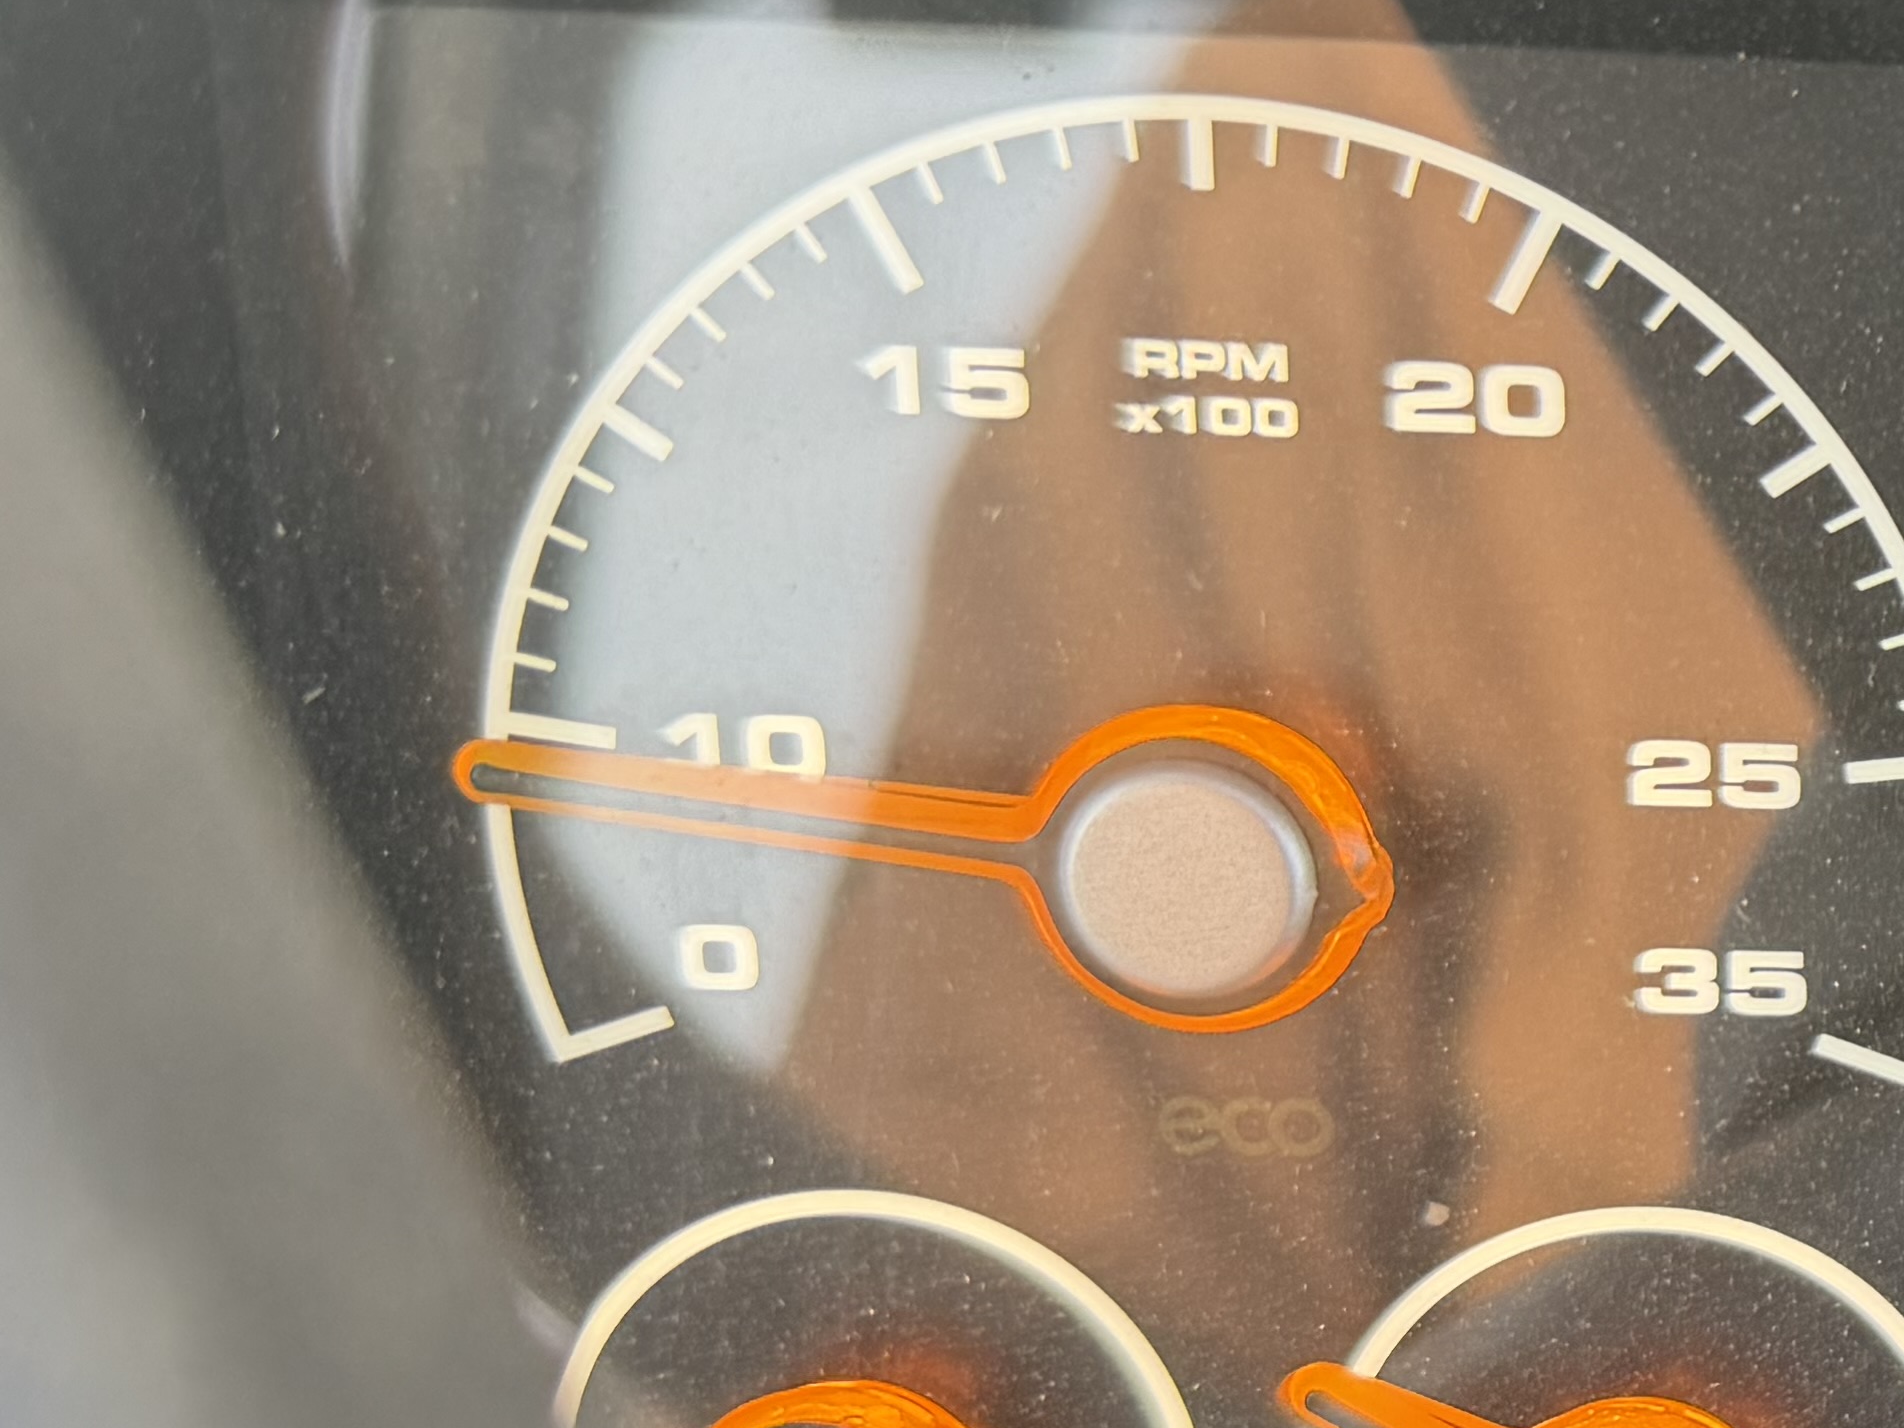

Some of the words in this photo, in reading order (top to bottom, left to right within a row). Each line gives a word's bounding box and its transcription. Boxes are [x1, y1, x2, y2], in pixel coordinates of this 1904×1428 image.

[863, 345, 1030, 420] 15
[1128, 337, 1289, 383] RPM
[1117, 395, 1299, 439] x100
[1384, 360, 1566, 438] 20
[660, 712, 826, 784] 10
[1626, 739, 1802, 810] 25
[678, 923, 760, 991] 0
[1634, 947, 1808, 1017] 35
